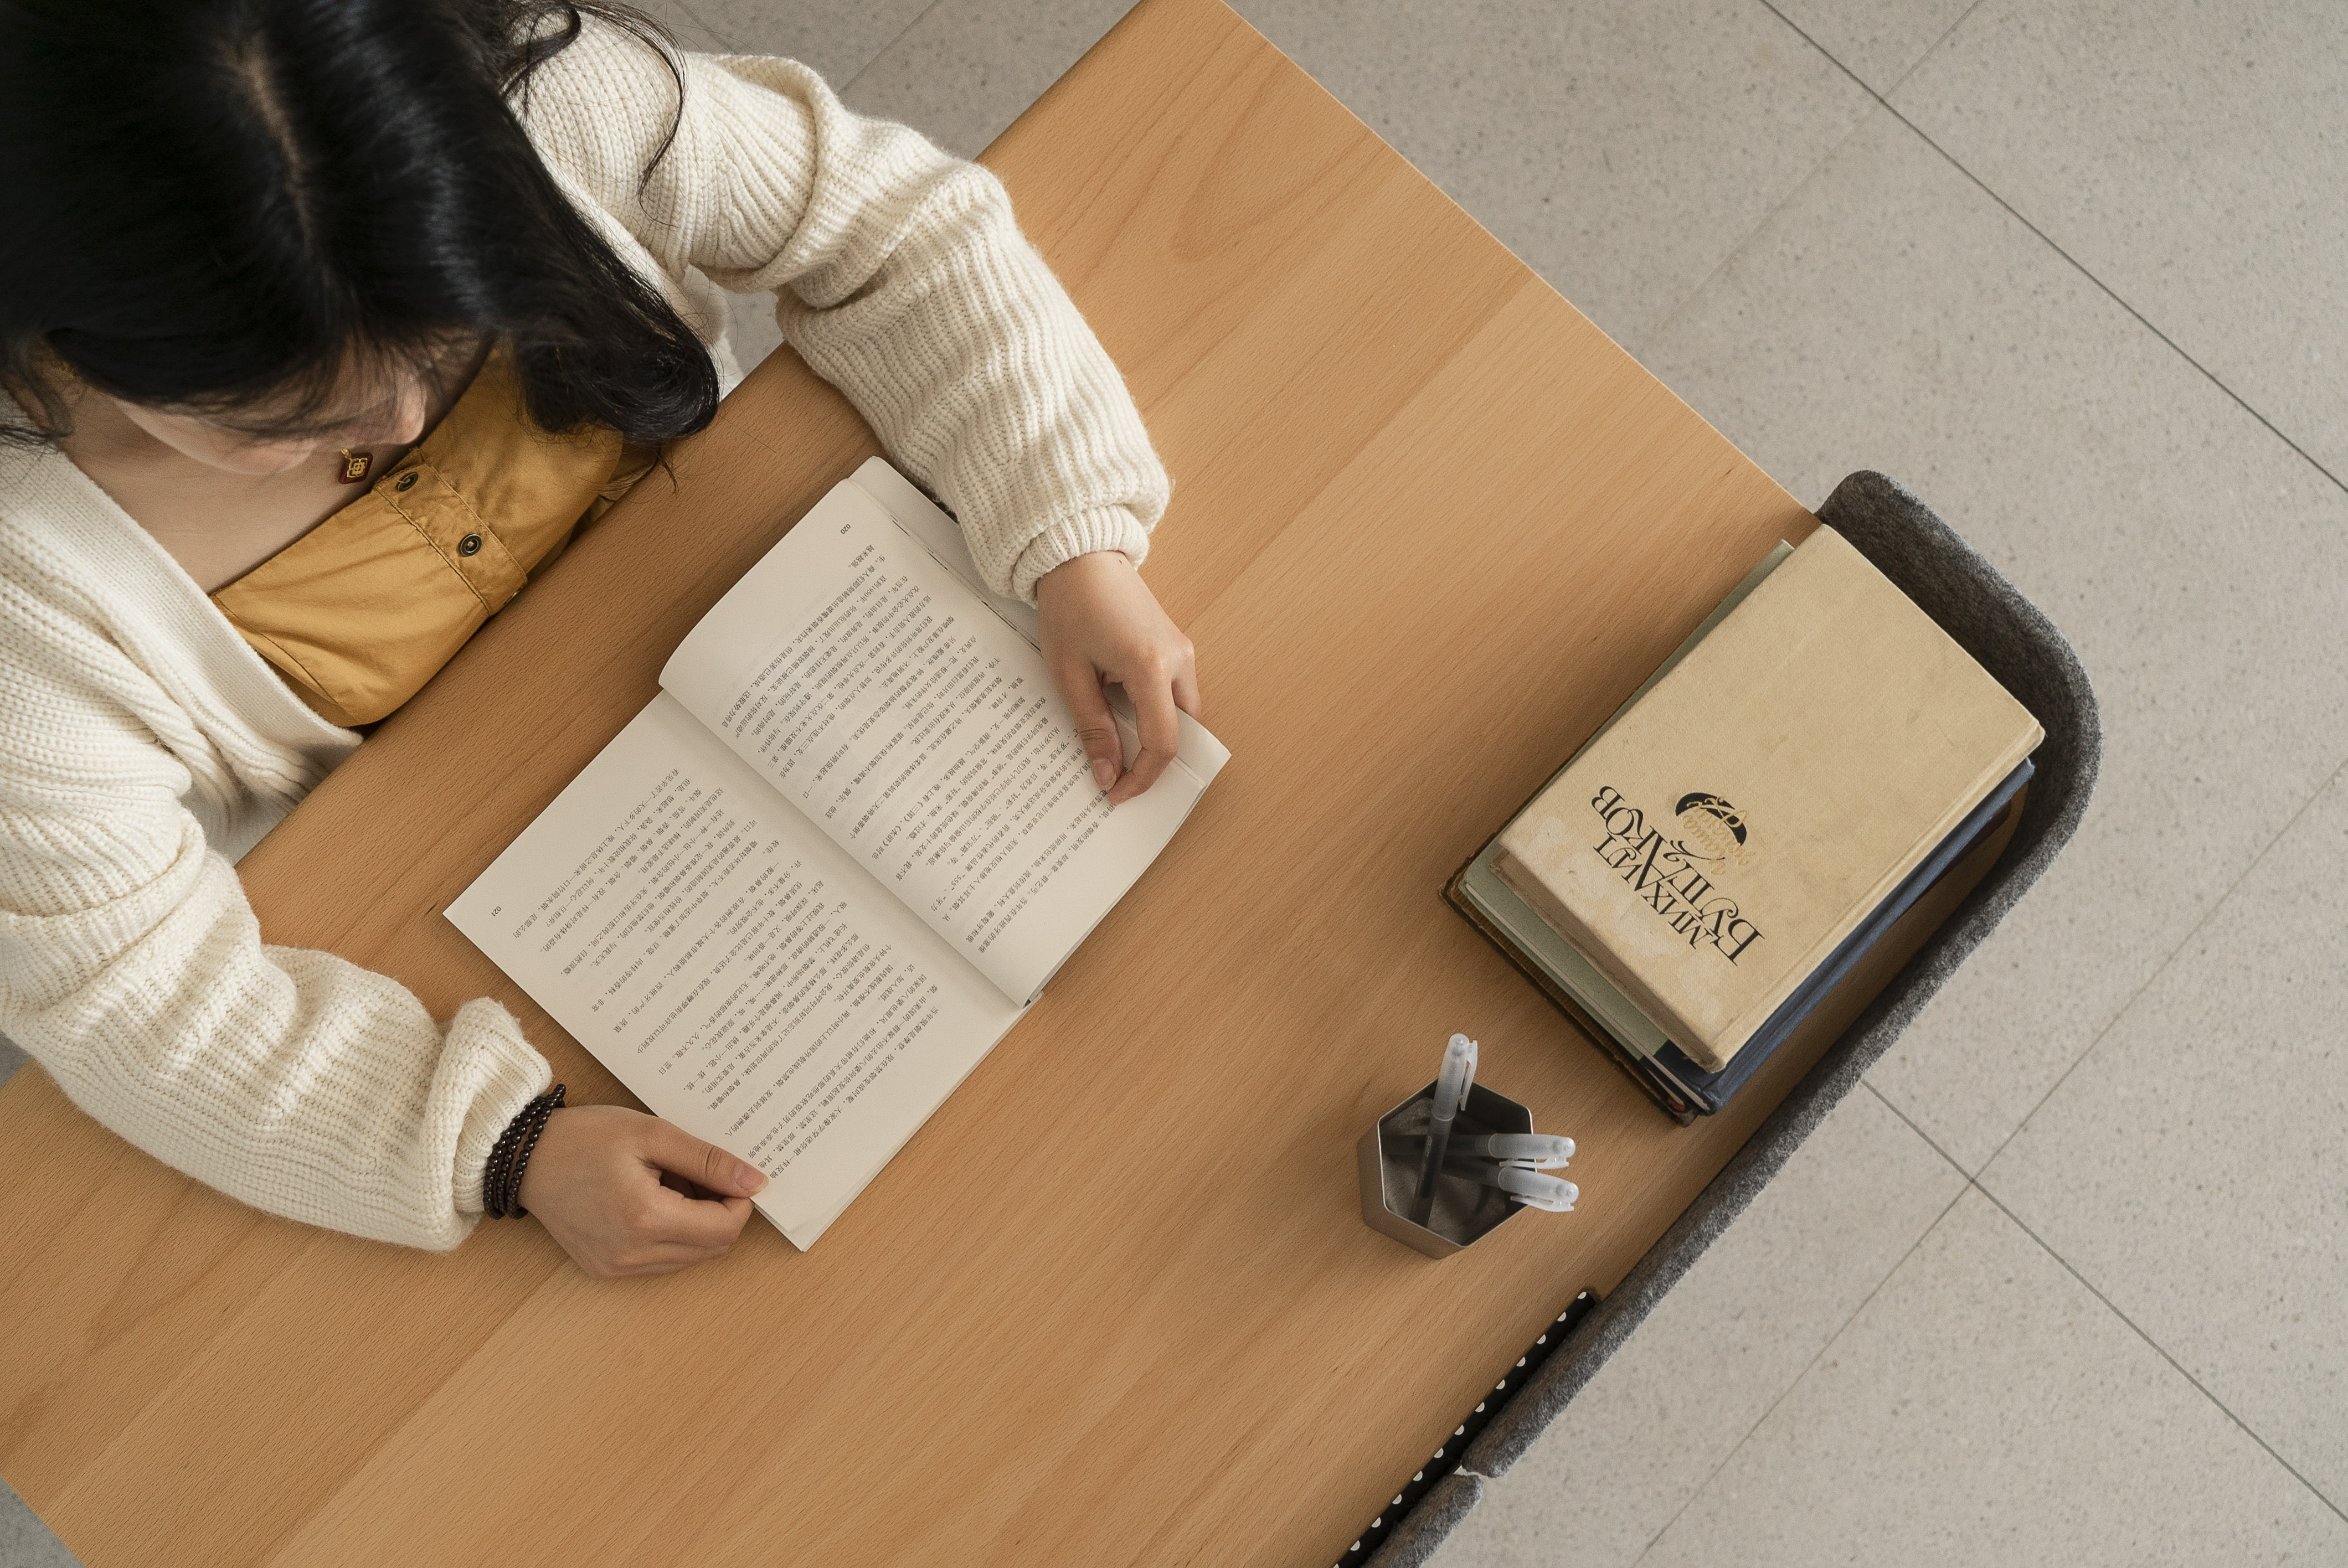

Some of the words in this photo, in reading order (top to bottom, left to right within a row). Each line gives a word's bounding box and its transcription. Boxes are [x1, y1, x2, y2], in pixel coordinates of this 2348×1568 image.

[839, 522, 851, 535] 020
[1591, 786, 1765, 966] БУЛГАКОВ
[1593, 829, 1713, 950] МИХАИЛ
[490, 905, 501, 917] 021
